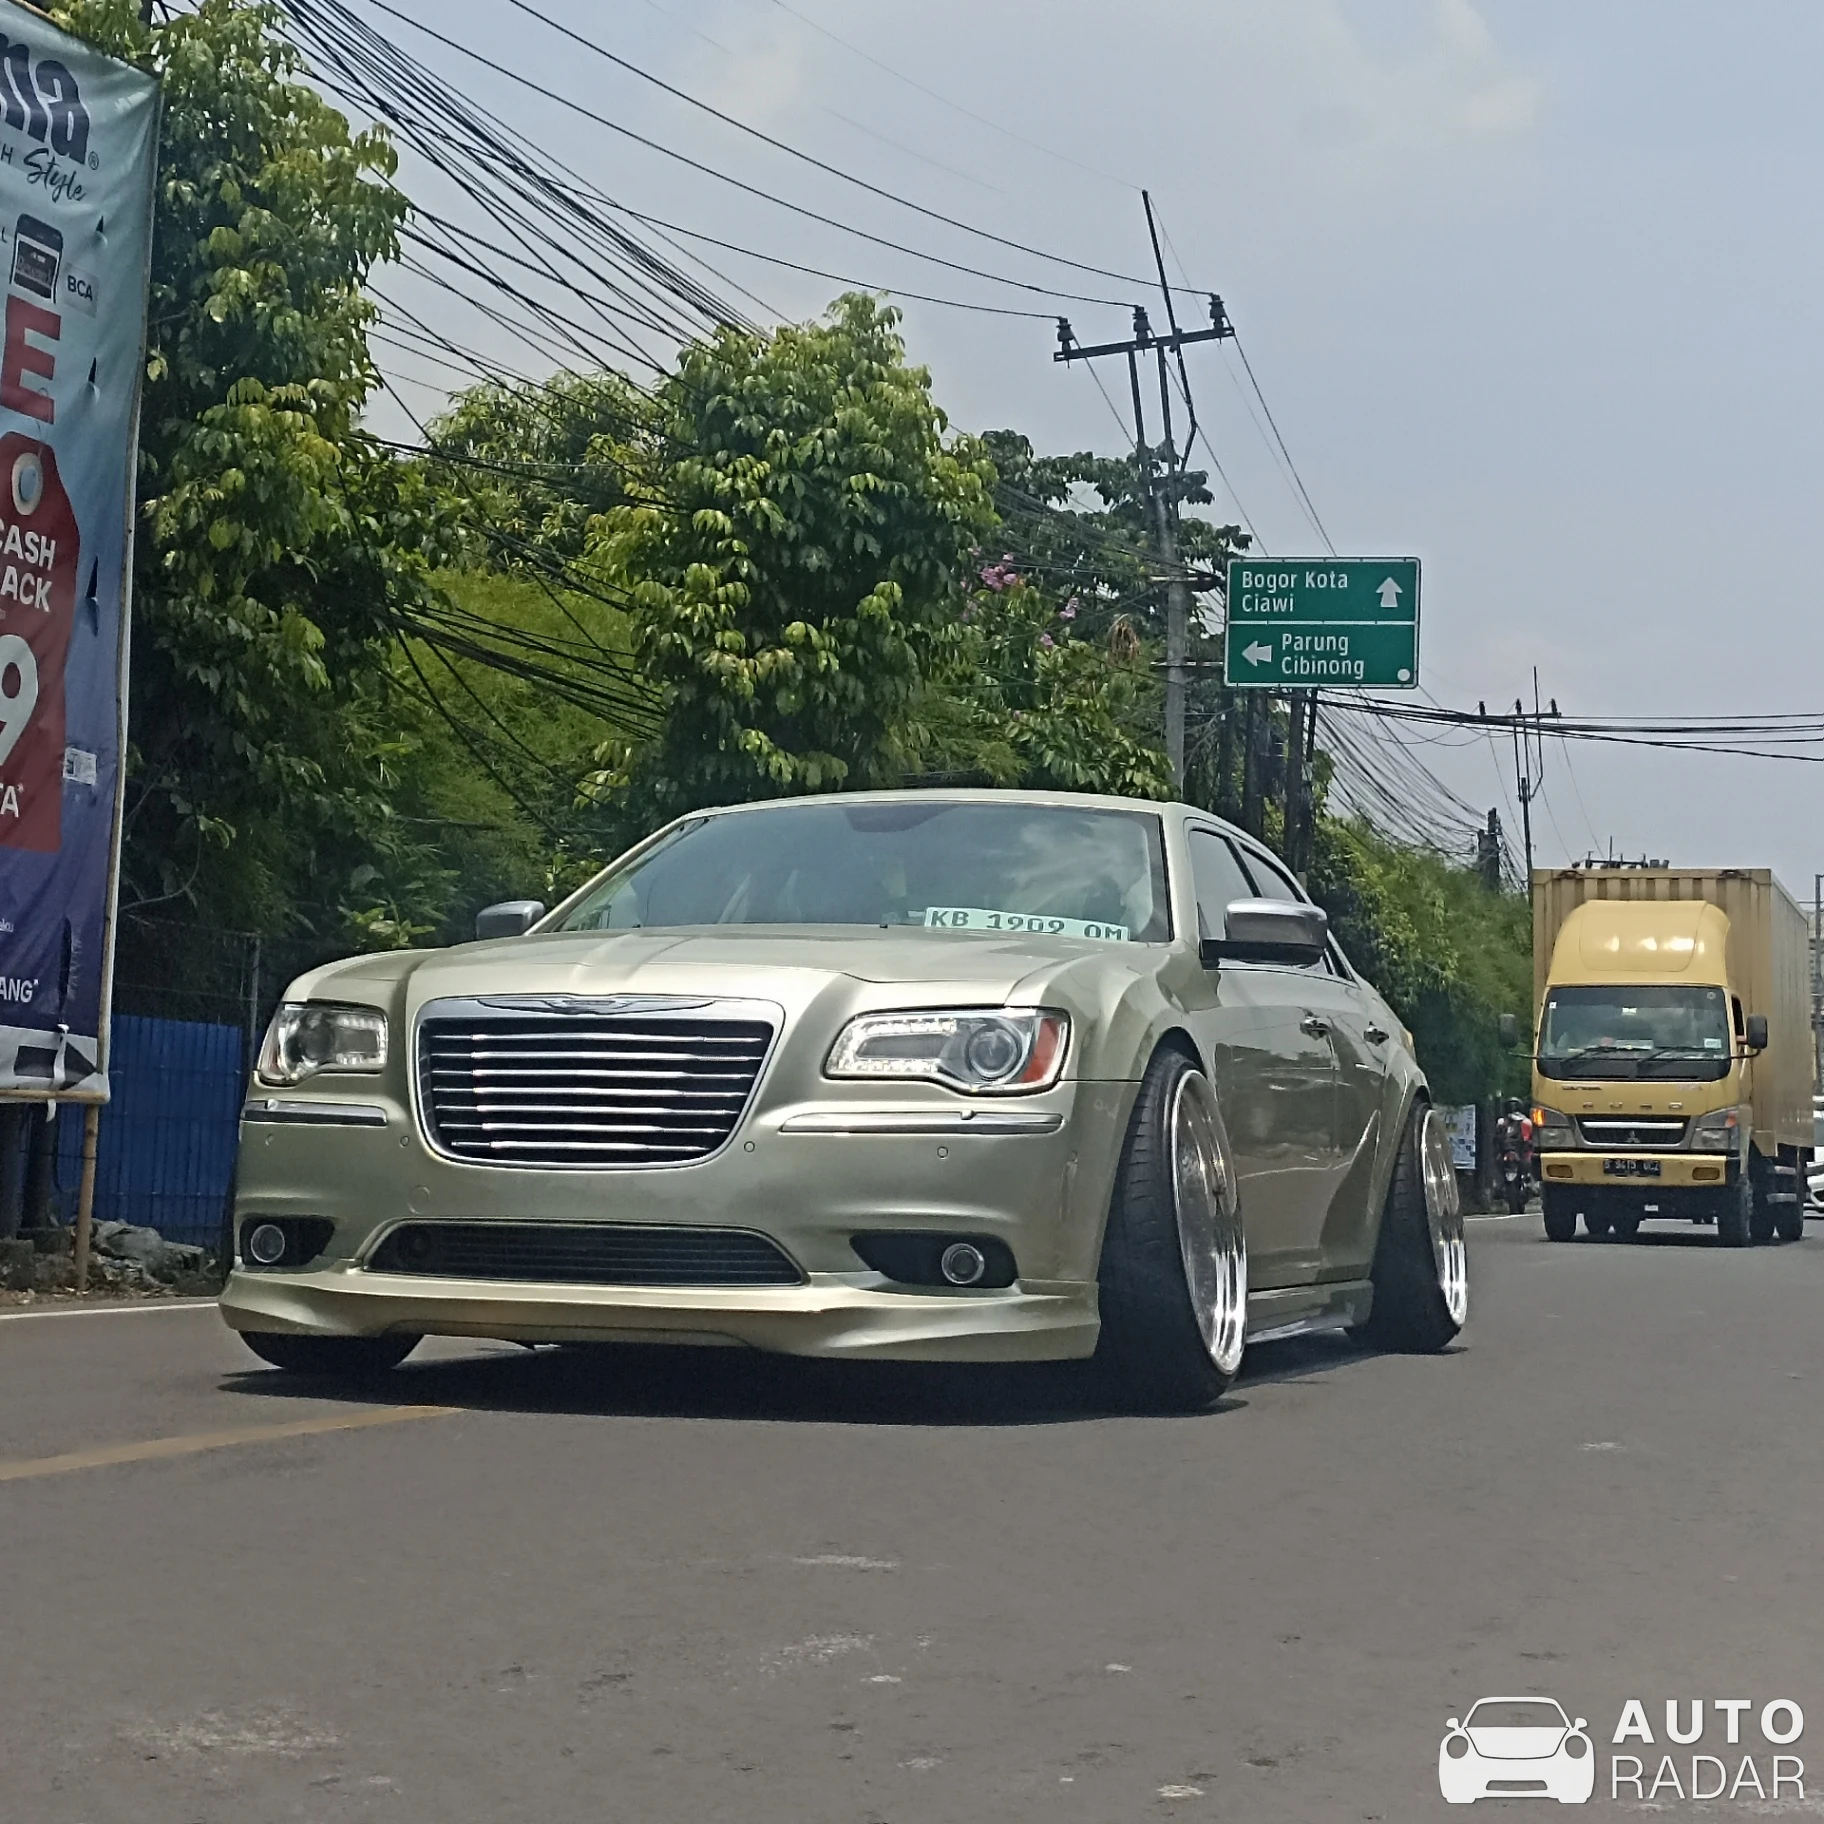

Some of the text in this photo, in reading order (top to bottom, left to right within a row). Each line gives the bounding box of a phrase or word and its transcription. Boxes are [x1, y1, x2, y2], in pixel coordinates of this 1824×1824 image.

[23, 147, 87, 204] Style
[67, 274, 94, 301] BCA
[0, 294, 62, 425] E
[1242, 571, 1349, 594] Bogor Kota
[1241, 593, 1295, 613] Ciawi
[1281, 633, 1350, 656] Parung
[1281, 656, 1365, 680] Cibinong
[930, 910, 970, 928] KB
